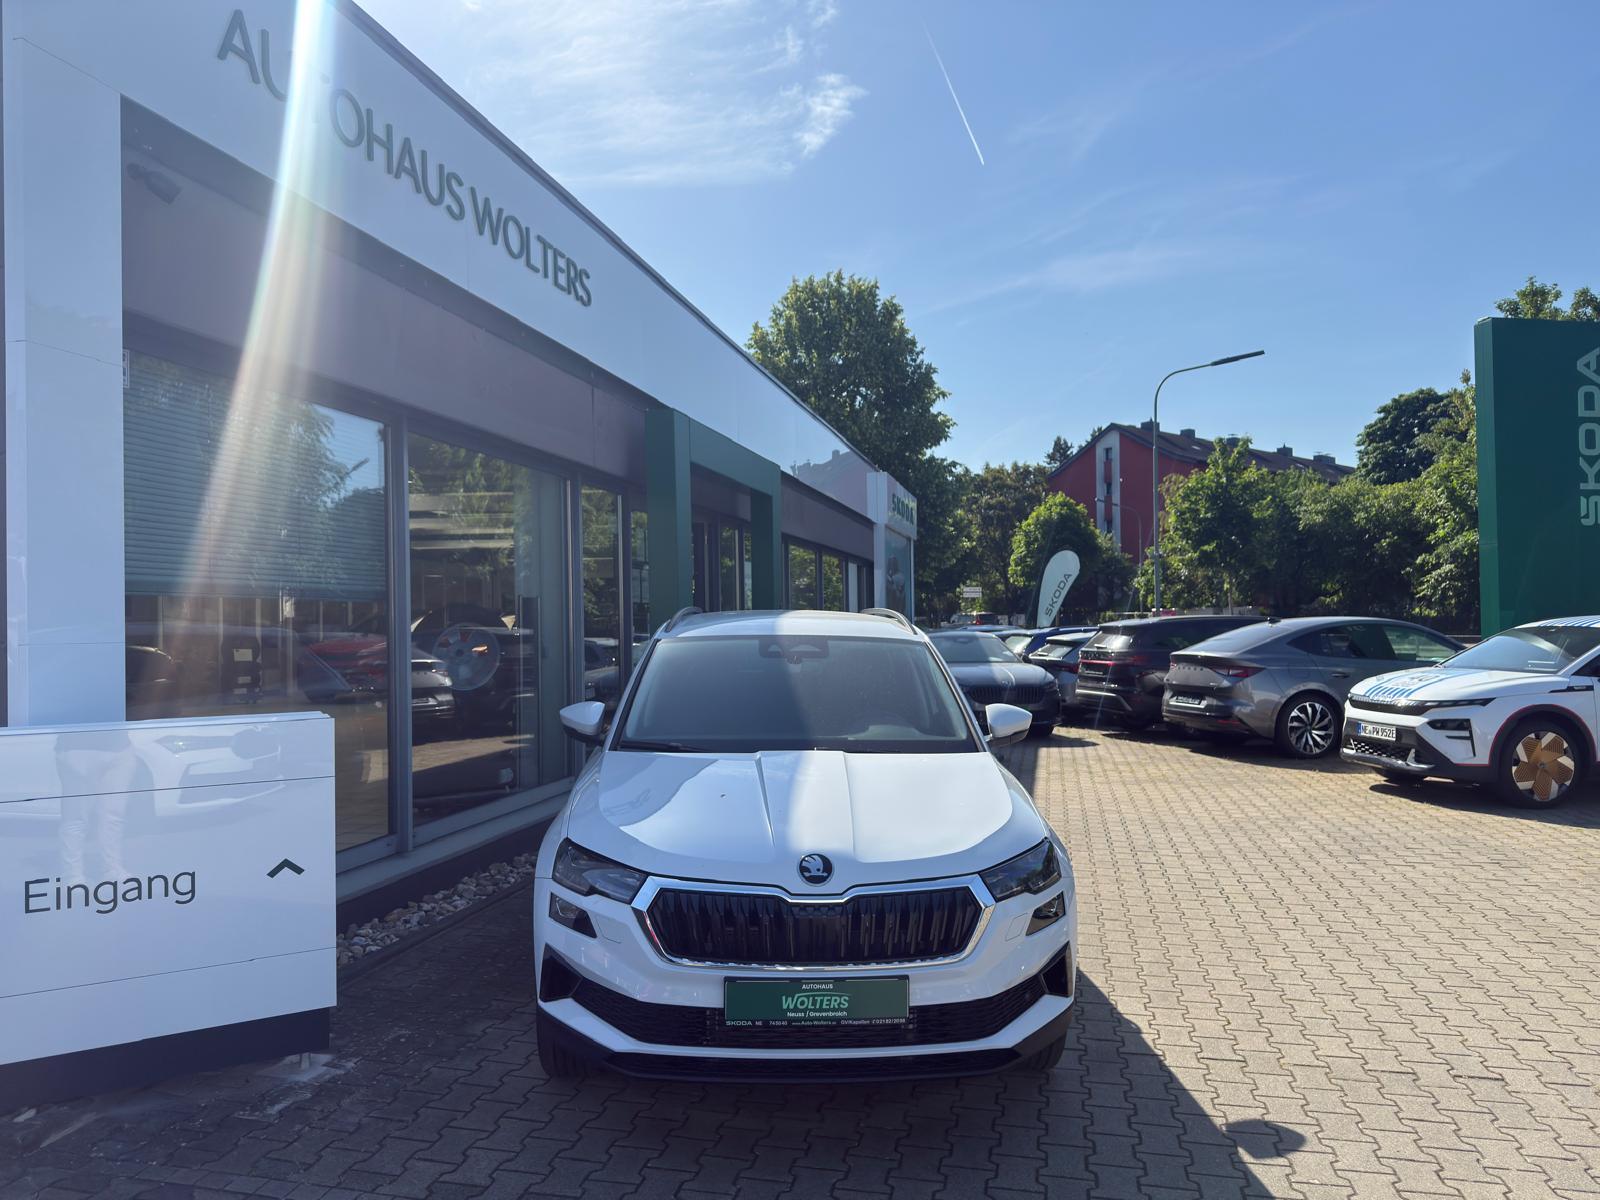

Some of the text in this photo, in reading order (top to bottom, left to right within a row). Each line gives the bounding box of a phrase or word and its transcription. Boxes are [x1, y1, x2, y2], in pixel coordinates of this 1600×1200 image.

[217, 9, 592, 307] AUOHAUS WOLTERS
[24, 871, 197, 915] Eingang
[781, 992, 851, 1010] WOLTERS
